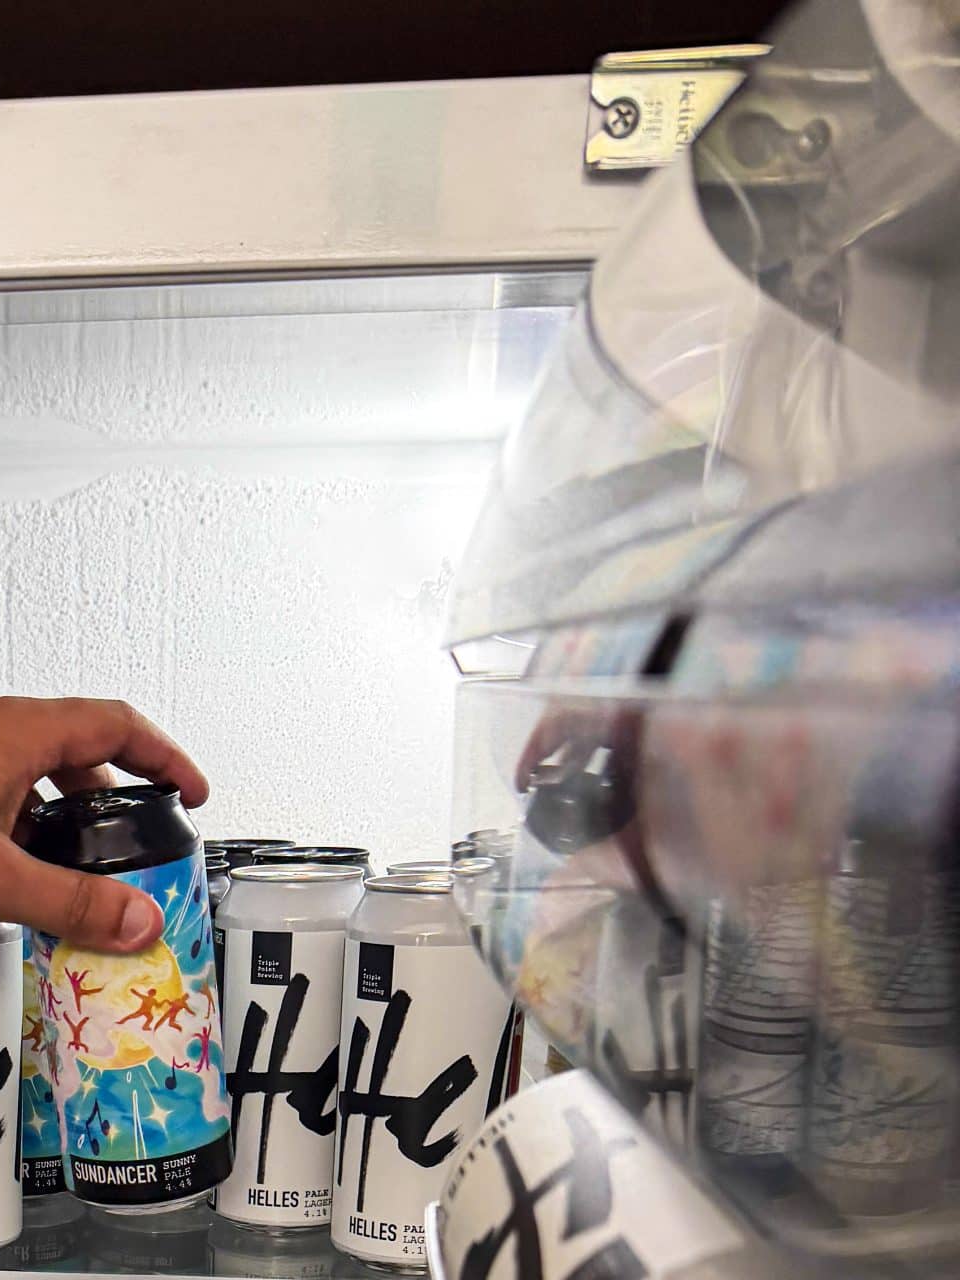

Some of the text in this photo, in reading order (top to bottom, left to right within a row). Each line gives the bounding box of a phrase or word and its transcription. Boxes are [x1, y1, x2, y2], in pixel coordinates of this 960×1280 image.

[34, 1159, 62, 1169] SUNNY
[162, 1154, 197, 1170] SUNNY
[34, 1169, 58, 1178] PALE
[74, 1162, 158, 1186] SUNDANCER
[163, 1167, 192, 1180] PALE
[248, 1188, 299, 1208] HELLES
[304, 1189, 329, 1198] PALE
[349, 1215, 398, 1242] HELLES
[402, 1224, 425, 1234] PAL
[402, 1235, 425, 1245] LAG
[402, 1246, 424, 1255] 4.1
